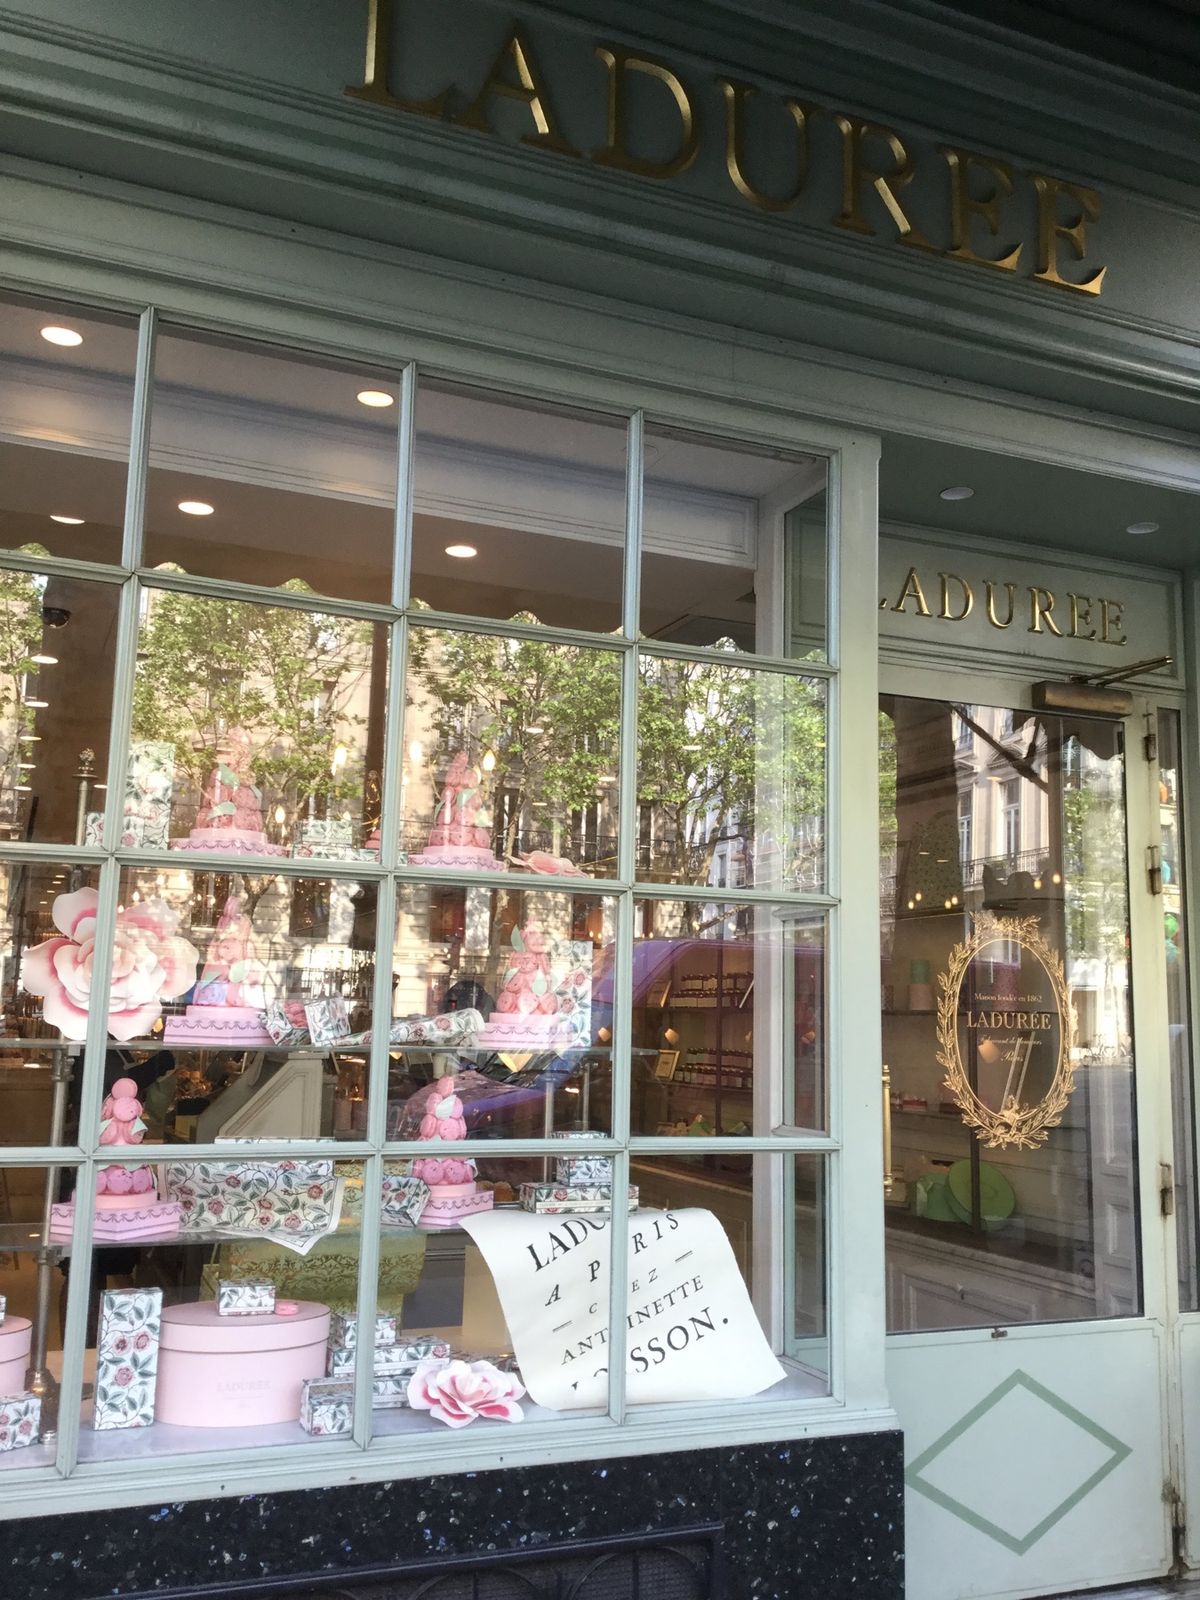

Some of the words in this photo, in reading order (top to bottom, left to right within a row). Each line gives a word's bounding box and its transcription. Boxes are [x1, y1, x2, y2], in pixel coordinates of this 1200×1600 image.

[343, 0, 1106, 297] LADUREE
[879, 567, 1128, 647] ADUREE
[966, 1010, 1052, 1030] LADURÉE
[974, 993, 996, 1001] Maison
[1027, 994, 1042, 1003] 1862
[545, 1283, 561, 1306] A
[588, 1213, 679, 1282] PRIS
[589, 1268, 658, 1314] CEZ
[561, 1275, 704, 1365] ANTINETTE
